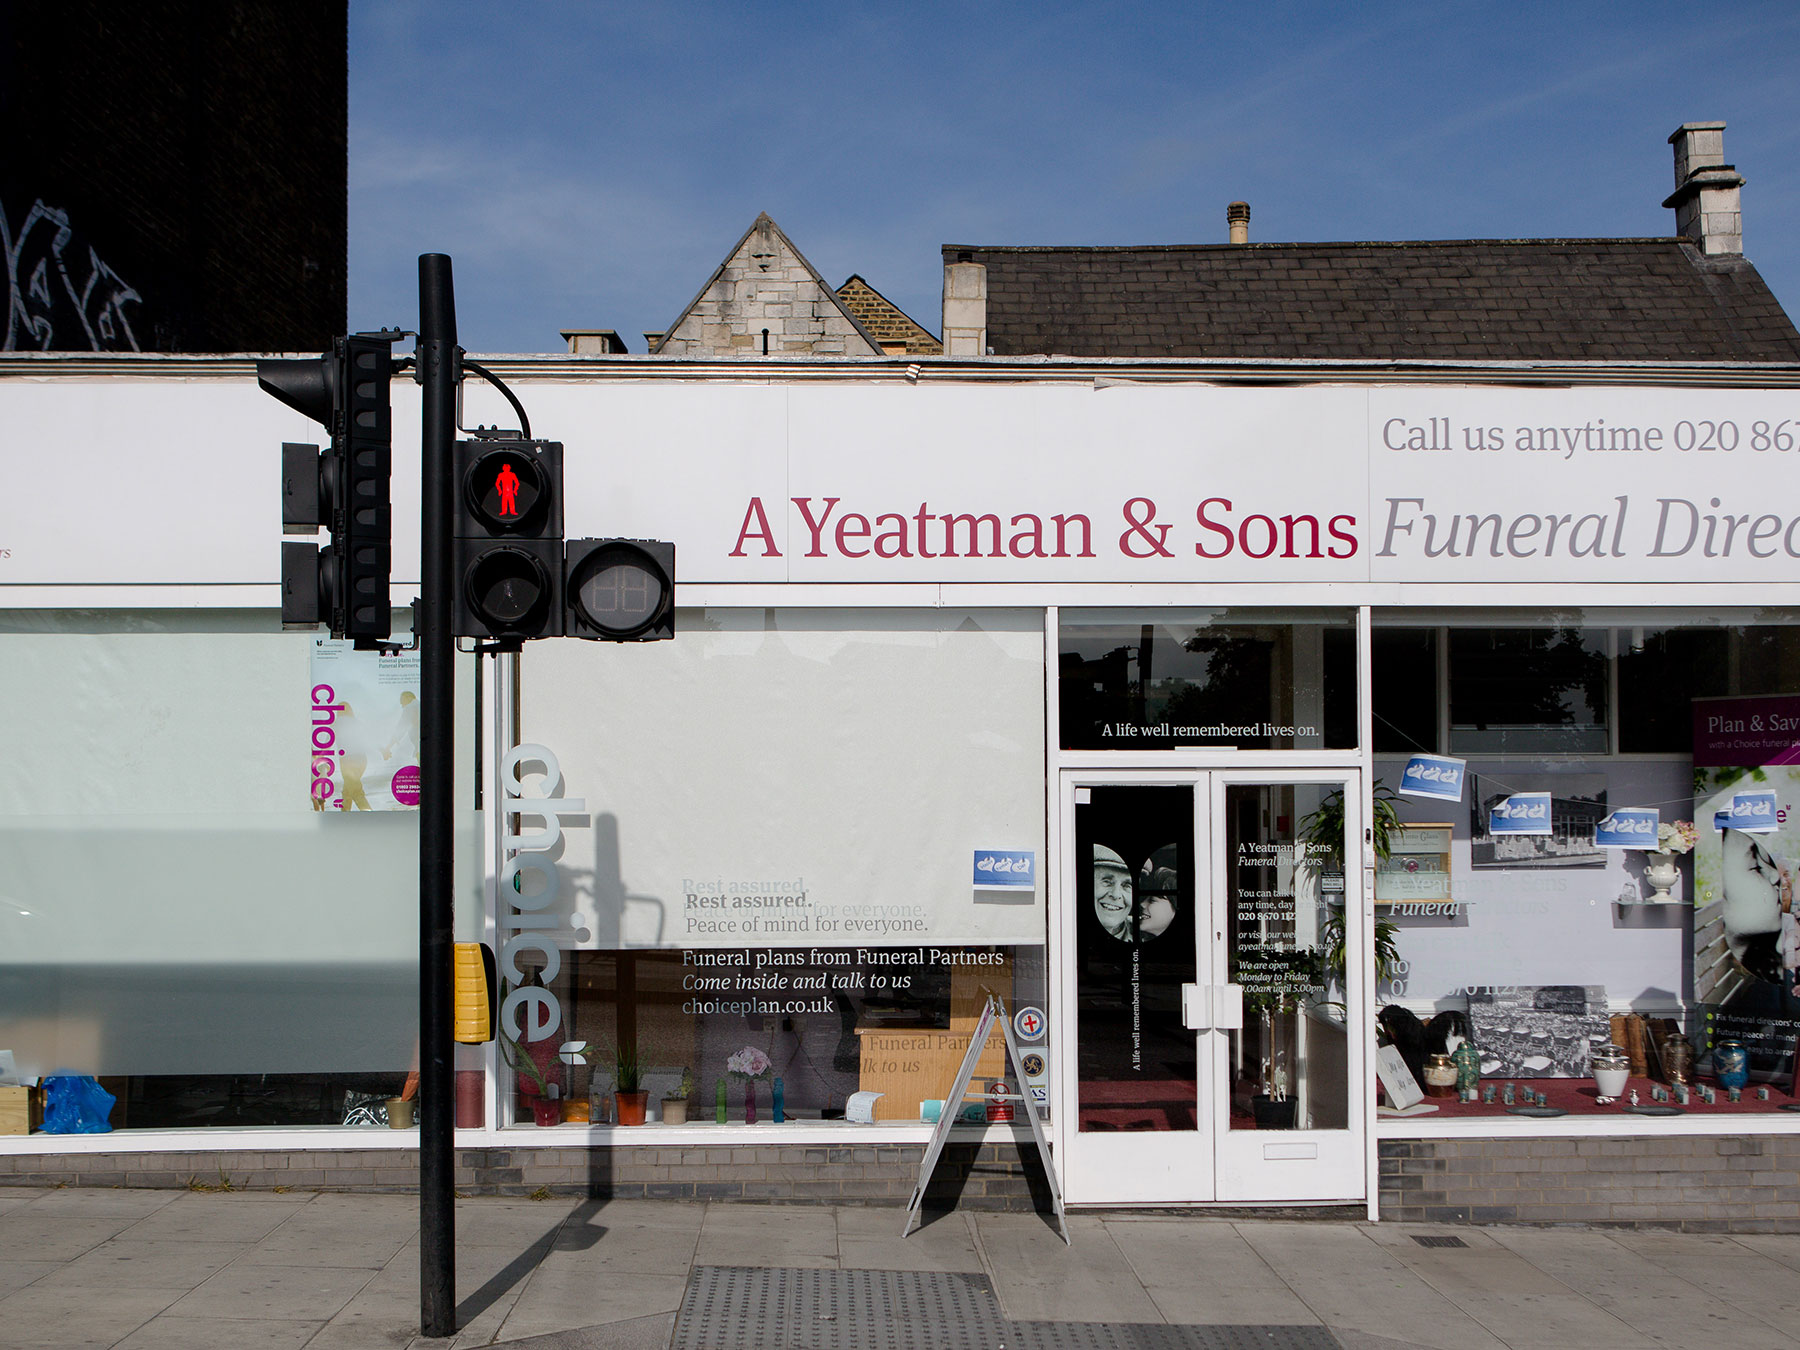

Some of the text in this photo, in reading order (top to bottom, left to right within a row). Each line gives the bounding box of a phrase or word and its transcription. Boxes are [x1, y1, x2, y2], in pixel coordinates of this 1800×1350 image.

[1382, 416, 1800, 460] Call us anytime 020 86
[728, 496, 1359, 559] A Yeatman & Sons
[1375, 495, 1629, 559] Funeral
[1101, 722, 1320, 737] A life well remembered lives on.
[1708, 714, 1745, 734] Plan
[1750, 714, 1765, 732] &
[311, 683, 346, 800] choice
[1735, 739, 1760, 749] Choice
[1762, 738, 1790, 748] funeral
[1238, 841, 1332, 854] A Yeatman Sons
[1238, 856, 1277, 867] Funeral
[500, 743, 586, 1044] choice
[686, 892, 813, 909] Rest assured.
[1238, 889, 1255, 898] You
[1256, 890, 1273, 898] can
[1238, 902, 1254, 911] any
[1255, 900, 1277, 910] time,
[1278, 900, 1295, 911] day
[1238, 911, 1256, 921] 020
[1257, 911, 1281, 921] 8670
[686, 915, 929, 935] Peace of mind for everyone.
[682, 948, 1004, 969] Funeral plans from Funeral Partners
[1239, 961, 1253, 969] We
[1268, 962, 1290, 971] open
[1131, 963, 1139, 981] lives
[1238, 972, 1311, 982] Monday to Friday
[682, 972, 912, 991] Come inside and talk to us
[1272, 984, 1292, 993] until
[1293, 984, 1325, 995] 5.00pm
[682, 997, 835, 1018] choiceplan.co.uk
[1131, 982, 1140, 1031] remembered
[1728, 1014, 1755, 1024] funeral
[869, 1034, 932, 1051] Funeral
[1132, 1032, 1140, 1049] well
[1132, 1050, 1141, 1063] life
